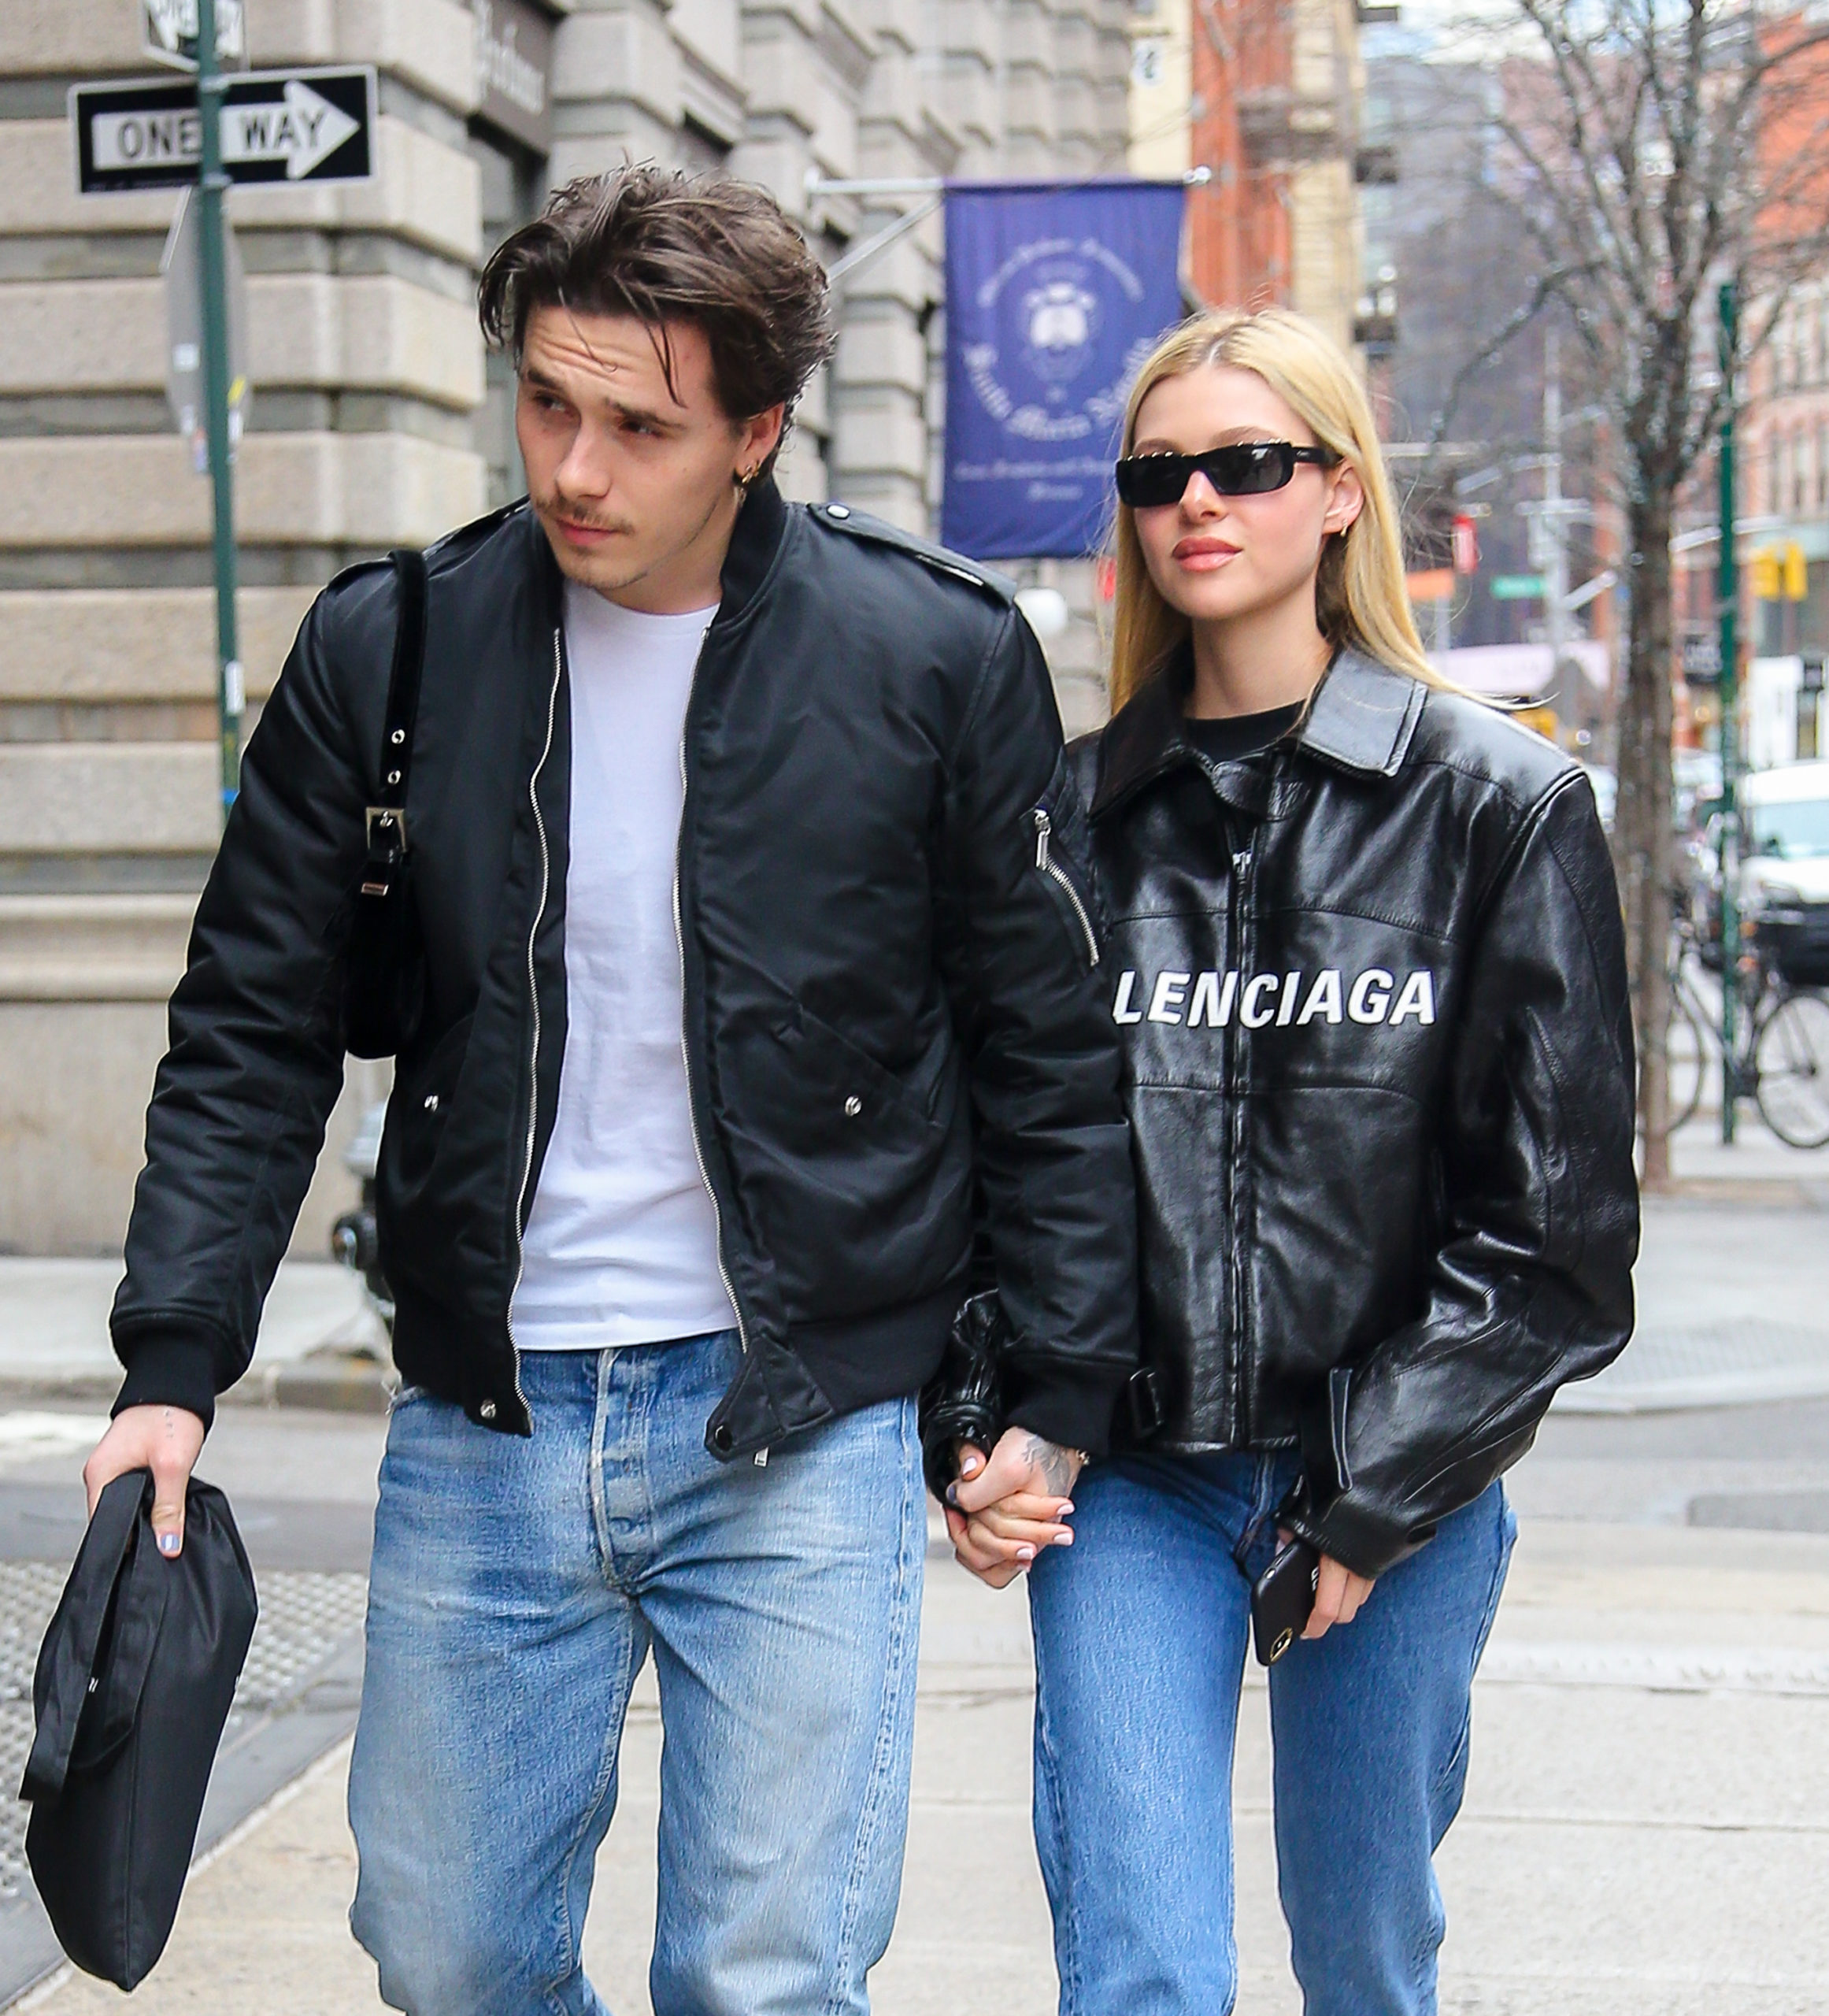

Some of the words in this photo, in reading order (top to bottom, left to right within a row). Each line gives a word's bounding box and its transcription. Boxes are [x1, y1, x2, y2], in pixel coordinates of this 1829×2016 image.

[117, 115, 201, 160] ONE
[240, 106, 327, 152] WAY
[1112, 968, 1435, 1029] LENCIAGA
